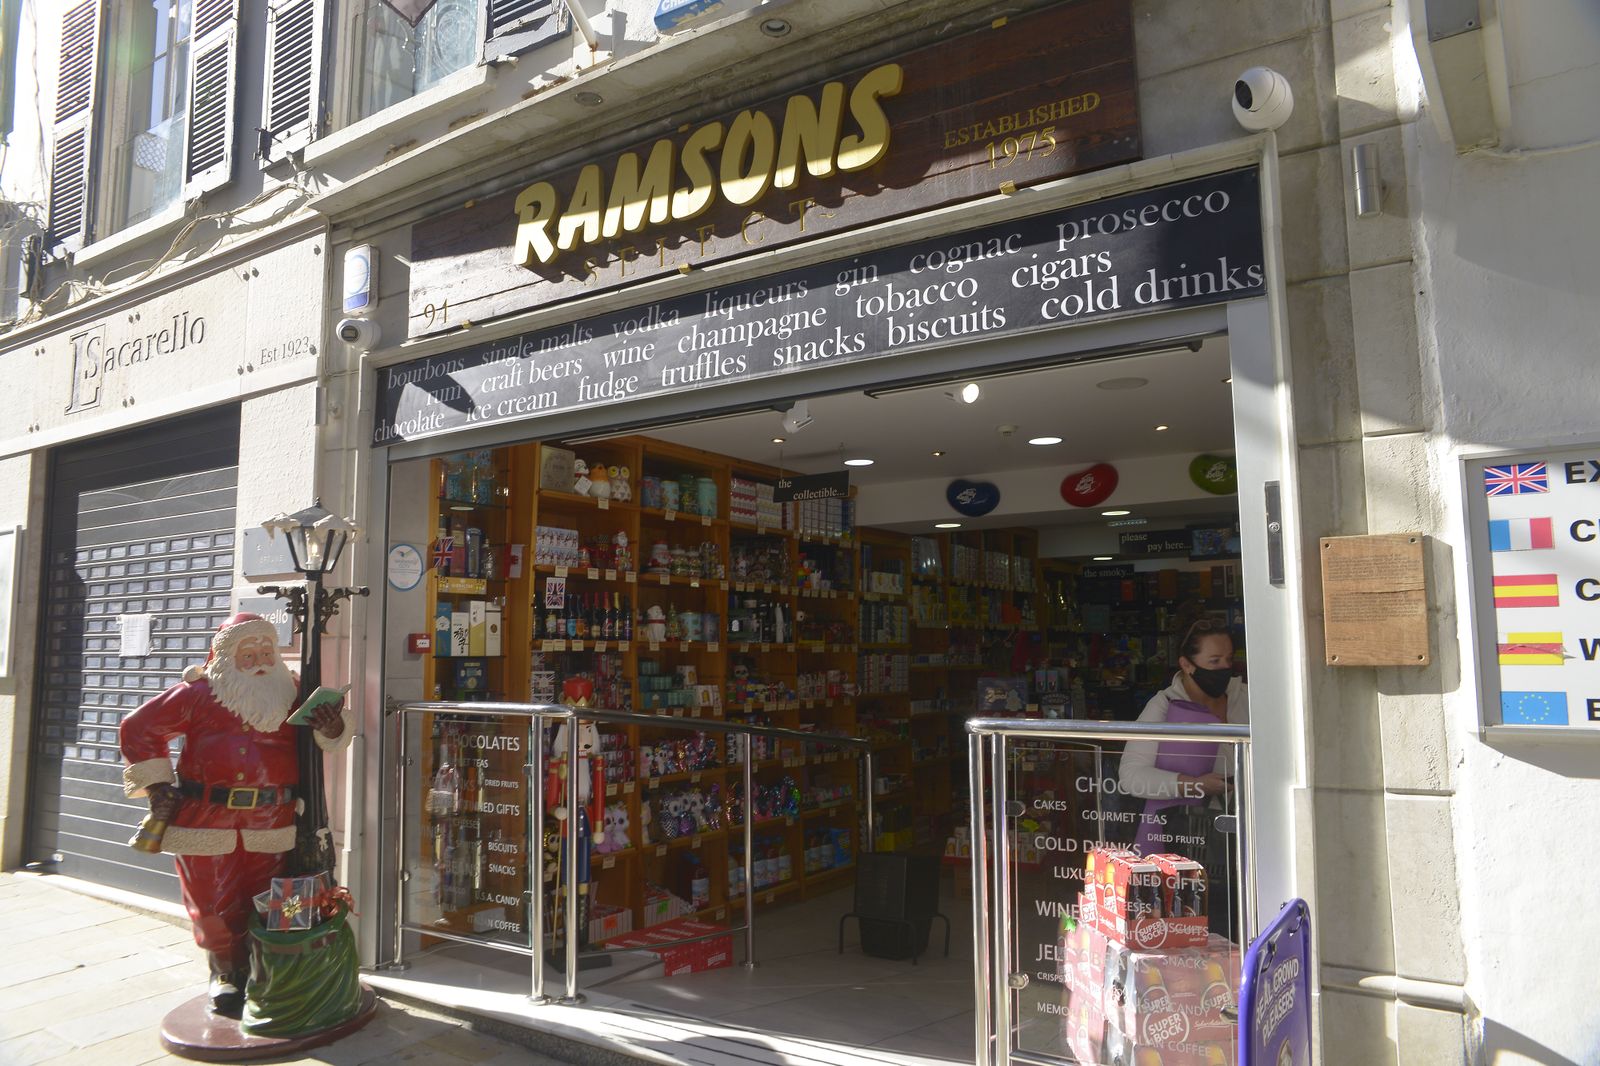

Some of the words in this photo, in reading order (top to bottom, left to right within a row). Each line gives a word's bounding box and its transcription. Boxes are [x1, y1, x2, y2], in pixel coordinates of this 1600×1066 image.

[944, 92, 1101, 149] ESTABLISHED
[985, 126, 1057, 169] 1975
[512, 63, 904, 267] RAMSONS
[388, 357, 465, 390] bourbons
[482, 341, 534, 366] single
[539, 324, 594, 353] malts
[612, 305, 682, 339] vodka
[704, 279, 808, 320] liqueurs
[834, 259, 880, 296] gin
[909, 232, 1022, 274] cognac
[1056, 190, 1230, 251] prosecco
[426, 384, 462, 407] rum
[481, 362, 523, 394] craft
[528, 356, 583, 384] beers
[604, 340, 656, 368] wine
[677, 306, 828, 354] champagne
[856, 277, 979, 318] tobacco
[1011, 250, 1112, 290] cigars
[260, 347, 279, 366] Est
[281, 336, 310, 362] 1923
[374, 409, 445, 442] chocolate
[466, 399, 492, 422] ice
[497, 389, 558, 415] cream
[577, 371, 640, 402] fudge
[662, 350, 748, 388] truffles
[773, 326, 867, 368] snacks
[887, 300, 1007, 348] biscuits
[1041, 275, 1122, 321] cold
[1134, 257, 1264, 305] drinks
[778, 478, 792, 489] the
[1121, 532, 1148, 544] please
[1147, 543, 1163, 553] pay
[1075, 776, 1205, 799] CHOCOLATES
[496, 803, 520, 816] GIFTS
[1033, 799, 1067, 811] CAKES
[1082, 809, 1136, 823] GOURMET
[1139, 813, 1168, 825] TEAS
[1034, 835, 1078, 853] COLD
[1083, 839, 1142, 857] DRINKS
[1147, 832, 1173, 843] DRIED
[1175, 834, 1206, 846] FRUITS
[488, 841, 518, 854] BISCUITS
[489, 863, 516, 876] SNACKS
[1166, 875, 1206, 892] GIFTS
[496, 894, 520, 907] CANDY
[494, 919, 521, 933] COFFEE
[1139, 921, 1162, 937] SUPER
[1162, 955, 1209, 970] SNACKS
[1148, 1012, 1182, 1036] SUPER
[1153, 1022, 1185, 1042] BOCK
